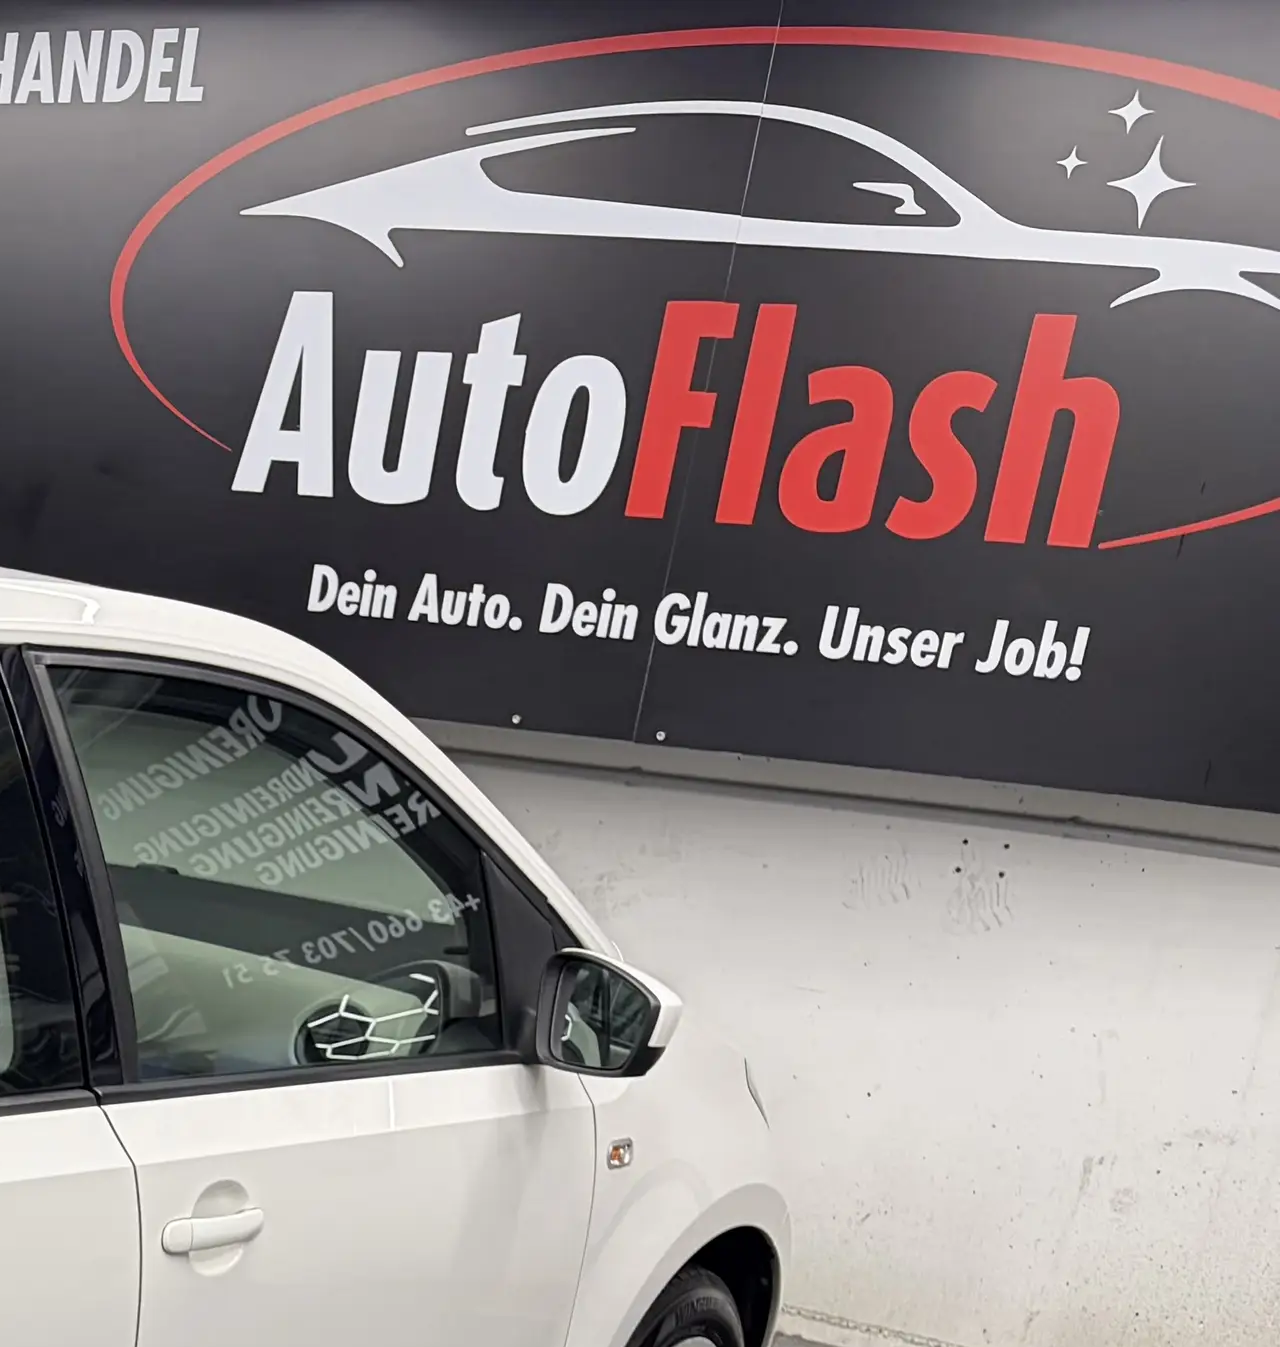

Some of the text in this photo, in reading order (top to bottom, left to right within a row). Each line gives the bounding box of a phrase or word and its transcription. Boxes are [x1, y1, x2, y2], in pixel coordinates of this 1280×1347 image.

[231, 290, 1121, 548] AutoFlash
[307, 563, 1091, 683] Dein Auto. Dein Glanz. Unser Job!
